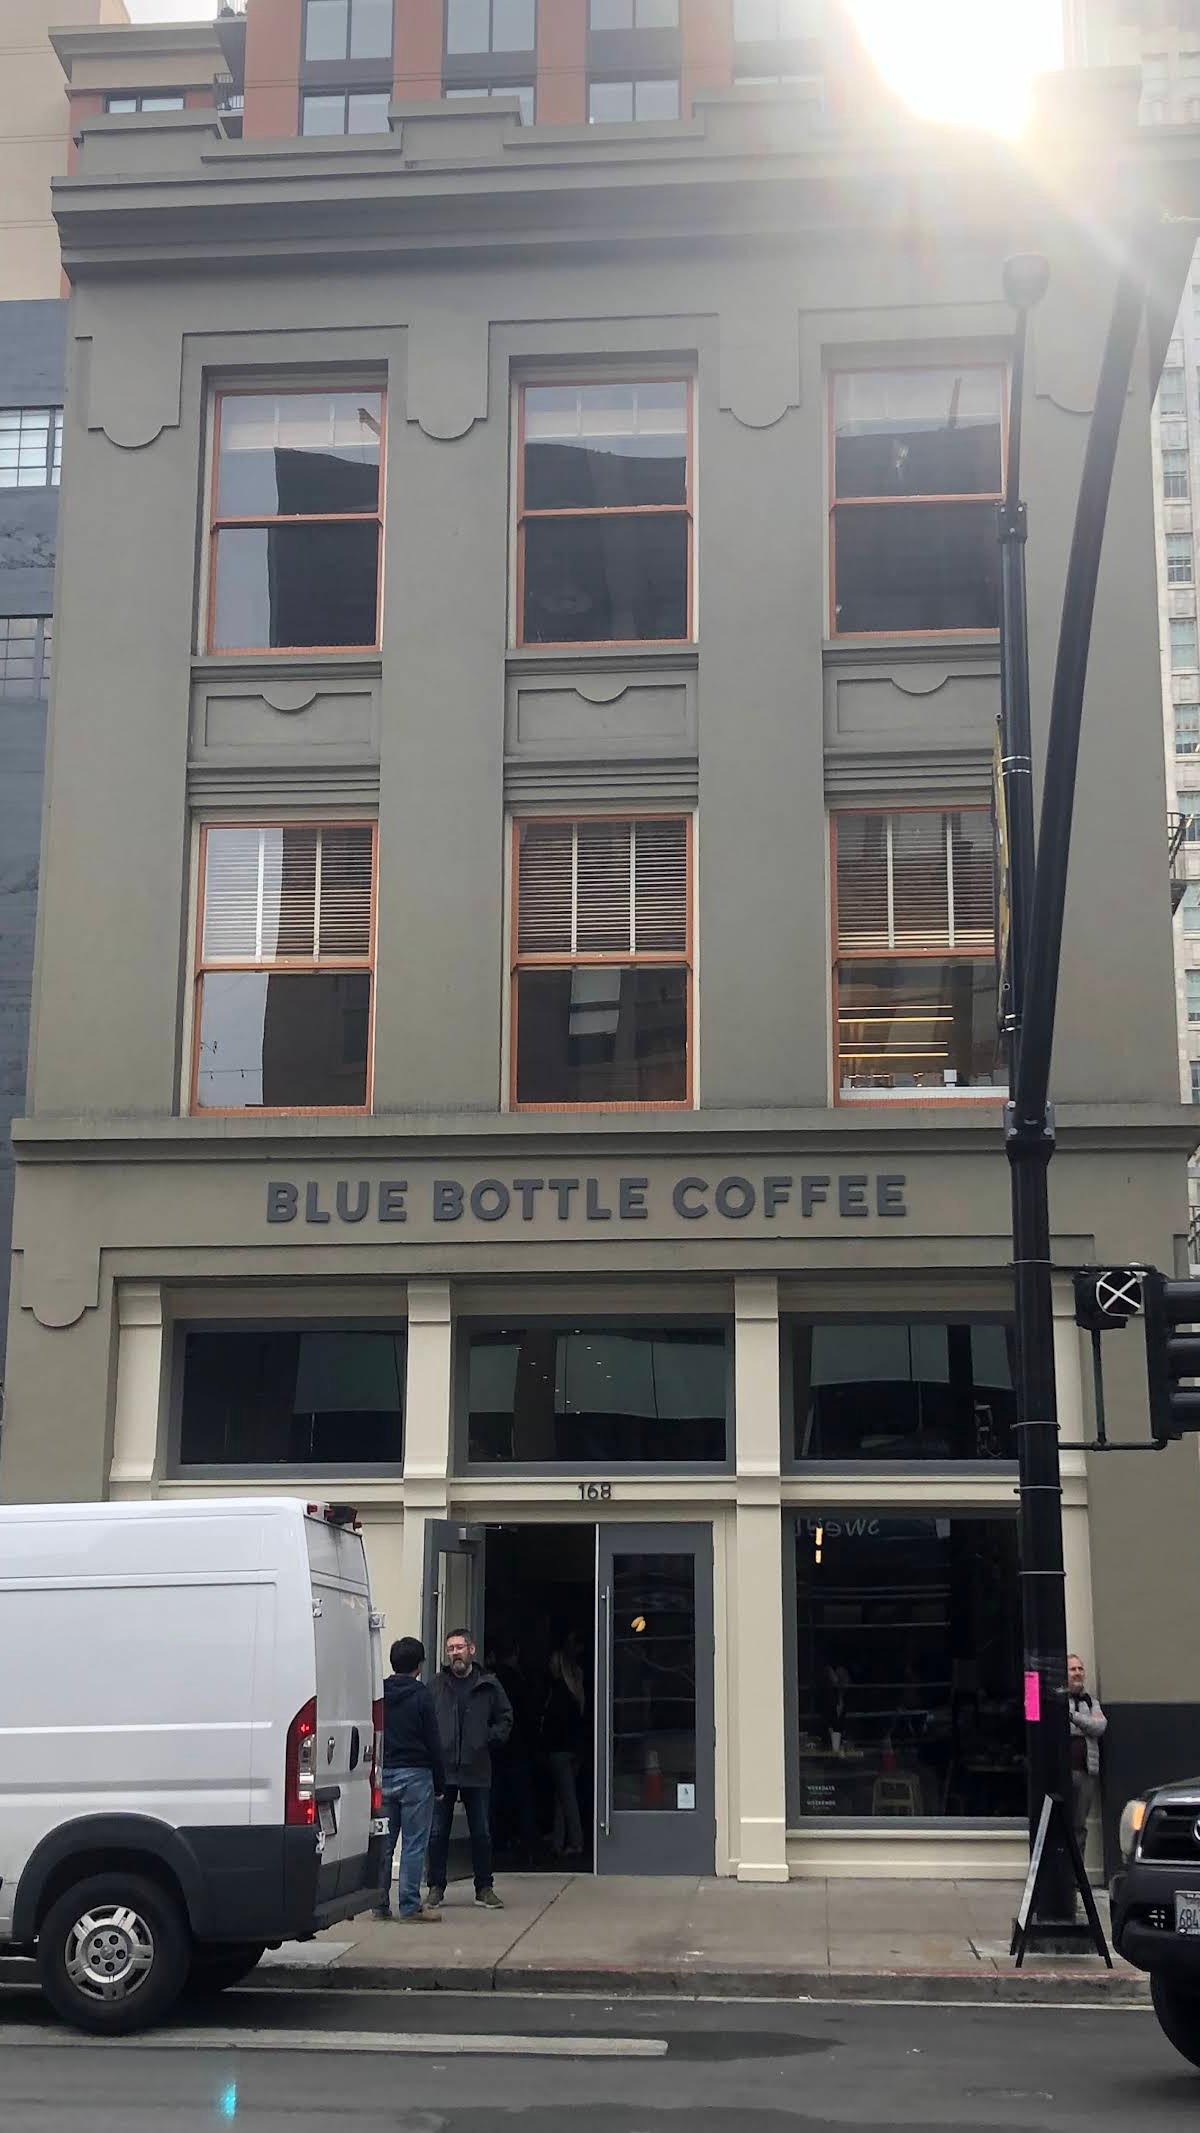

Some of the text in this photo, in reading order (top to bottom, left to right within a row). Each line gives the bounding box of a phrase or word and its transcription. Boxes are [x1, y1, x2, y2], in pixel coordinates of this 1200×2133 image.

[266, 1174, 907, 1223] BLUE BOTTLE COFFEE
[578, 1482, 611, 1501] 168
